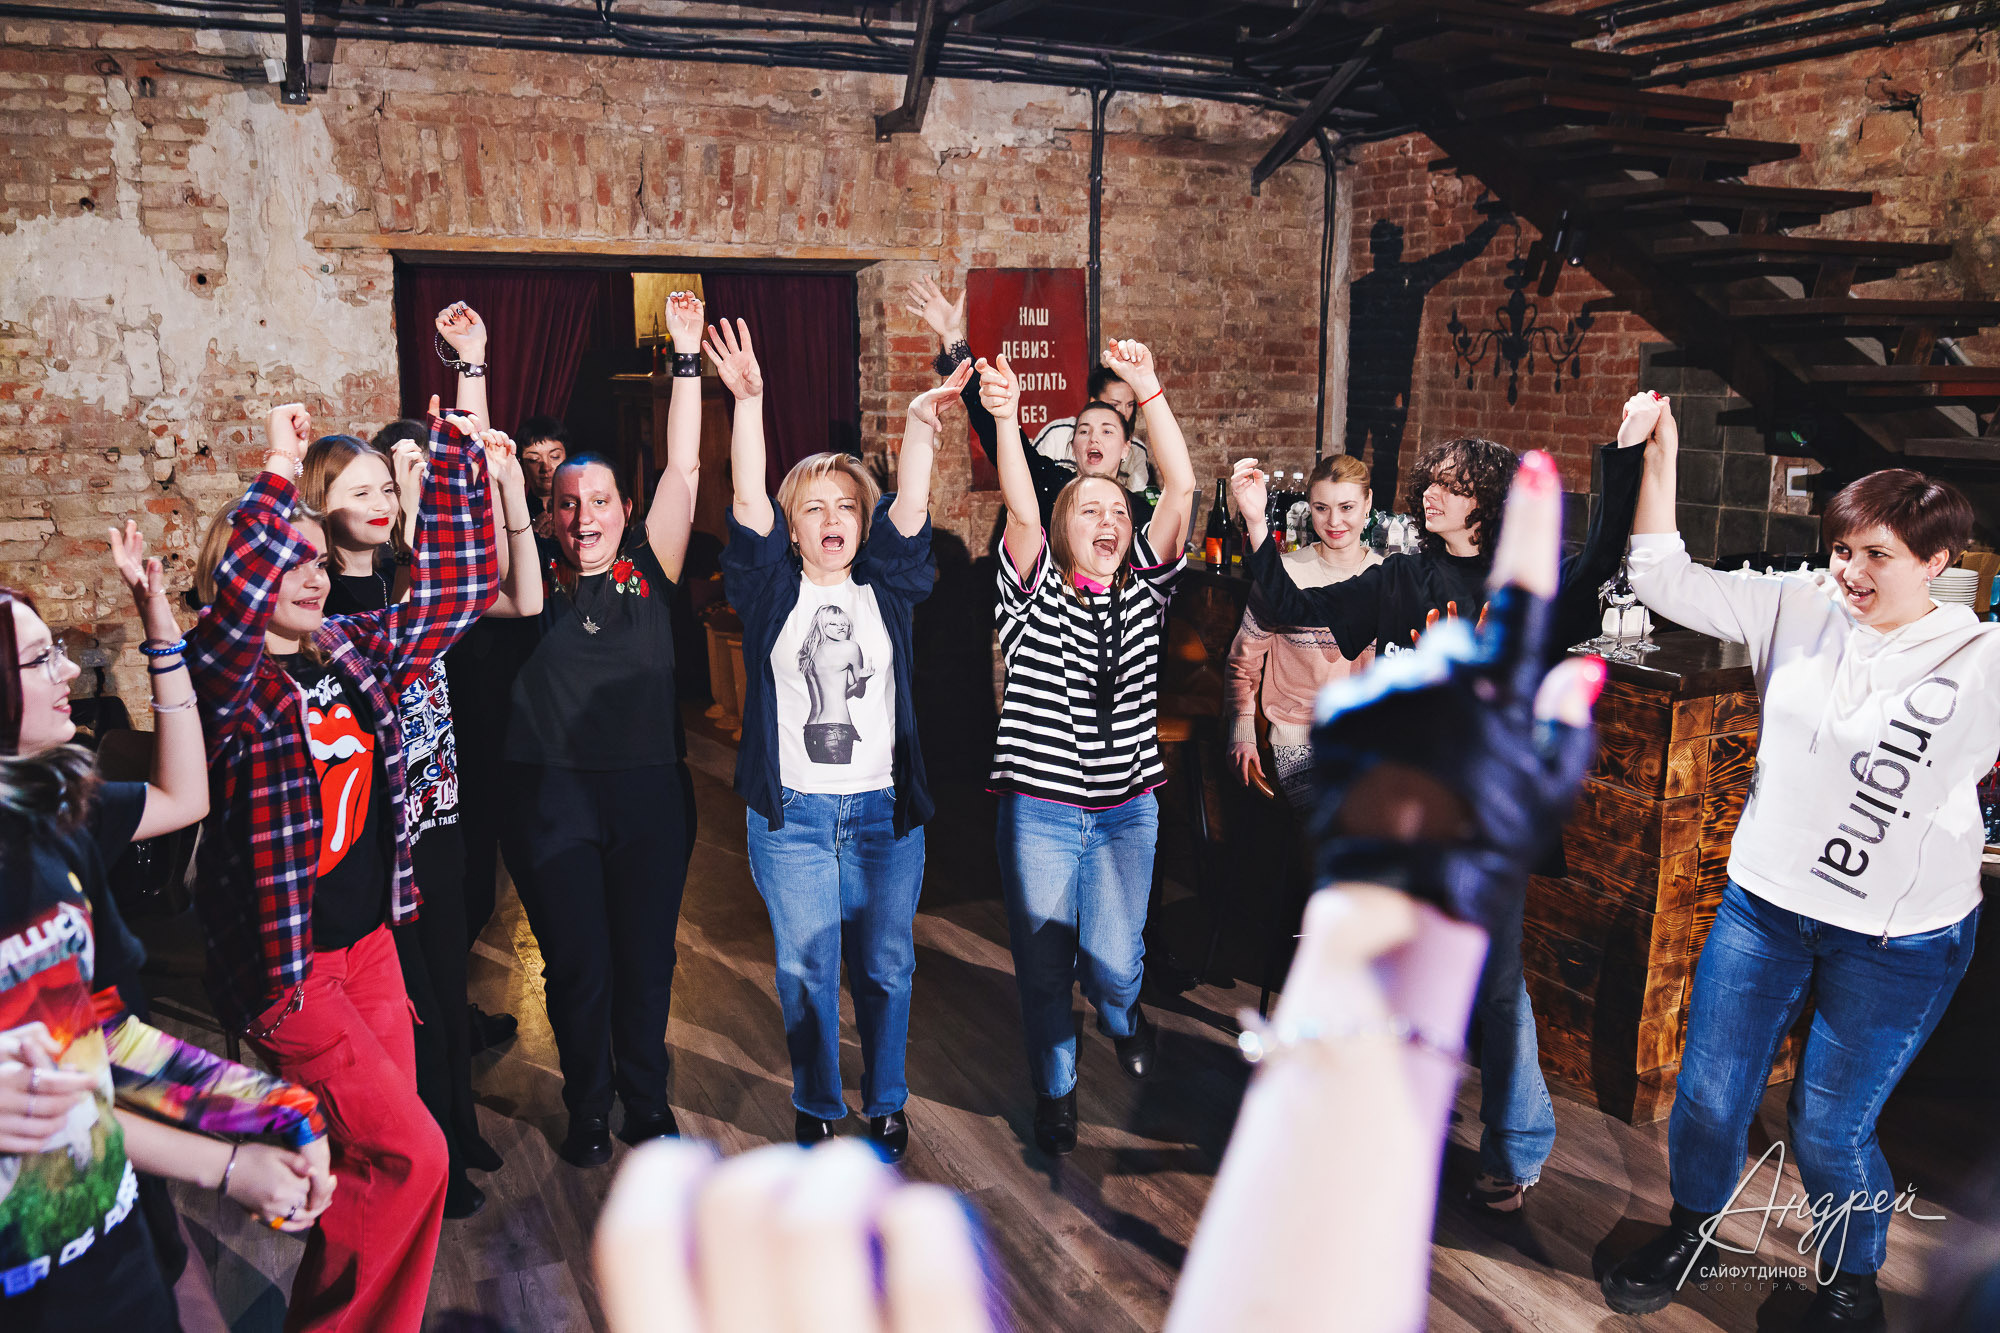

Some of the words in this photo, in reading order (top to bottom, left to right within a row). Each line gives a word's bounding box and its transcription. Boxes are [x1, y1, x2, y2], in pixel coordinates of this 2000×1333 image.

[1019, 306, 1049, 326] НАШ
[1018, 372, 1067, 392] БОТАТЬ
[1021, 405, 1048, 424] БЕЗ
[438, 813, 457, 826] TAKE
